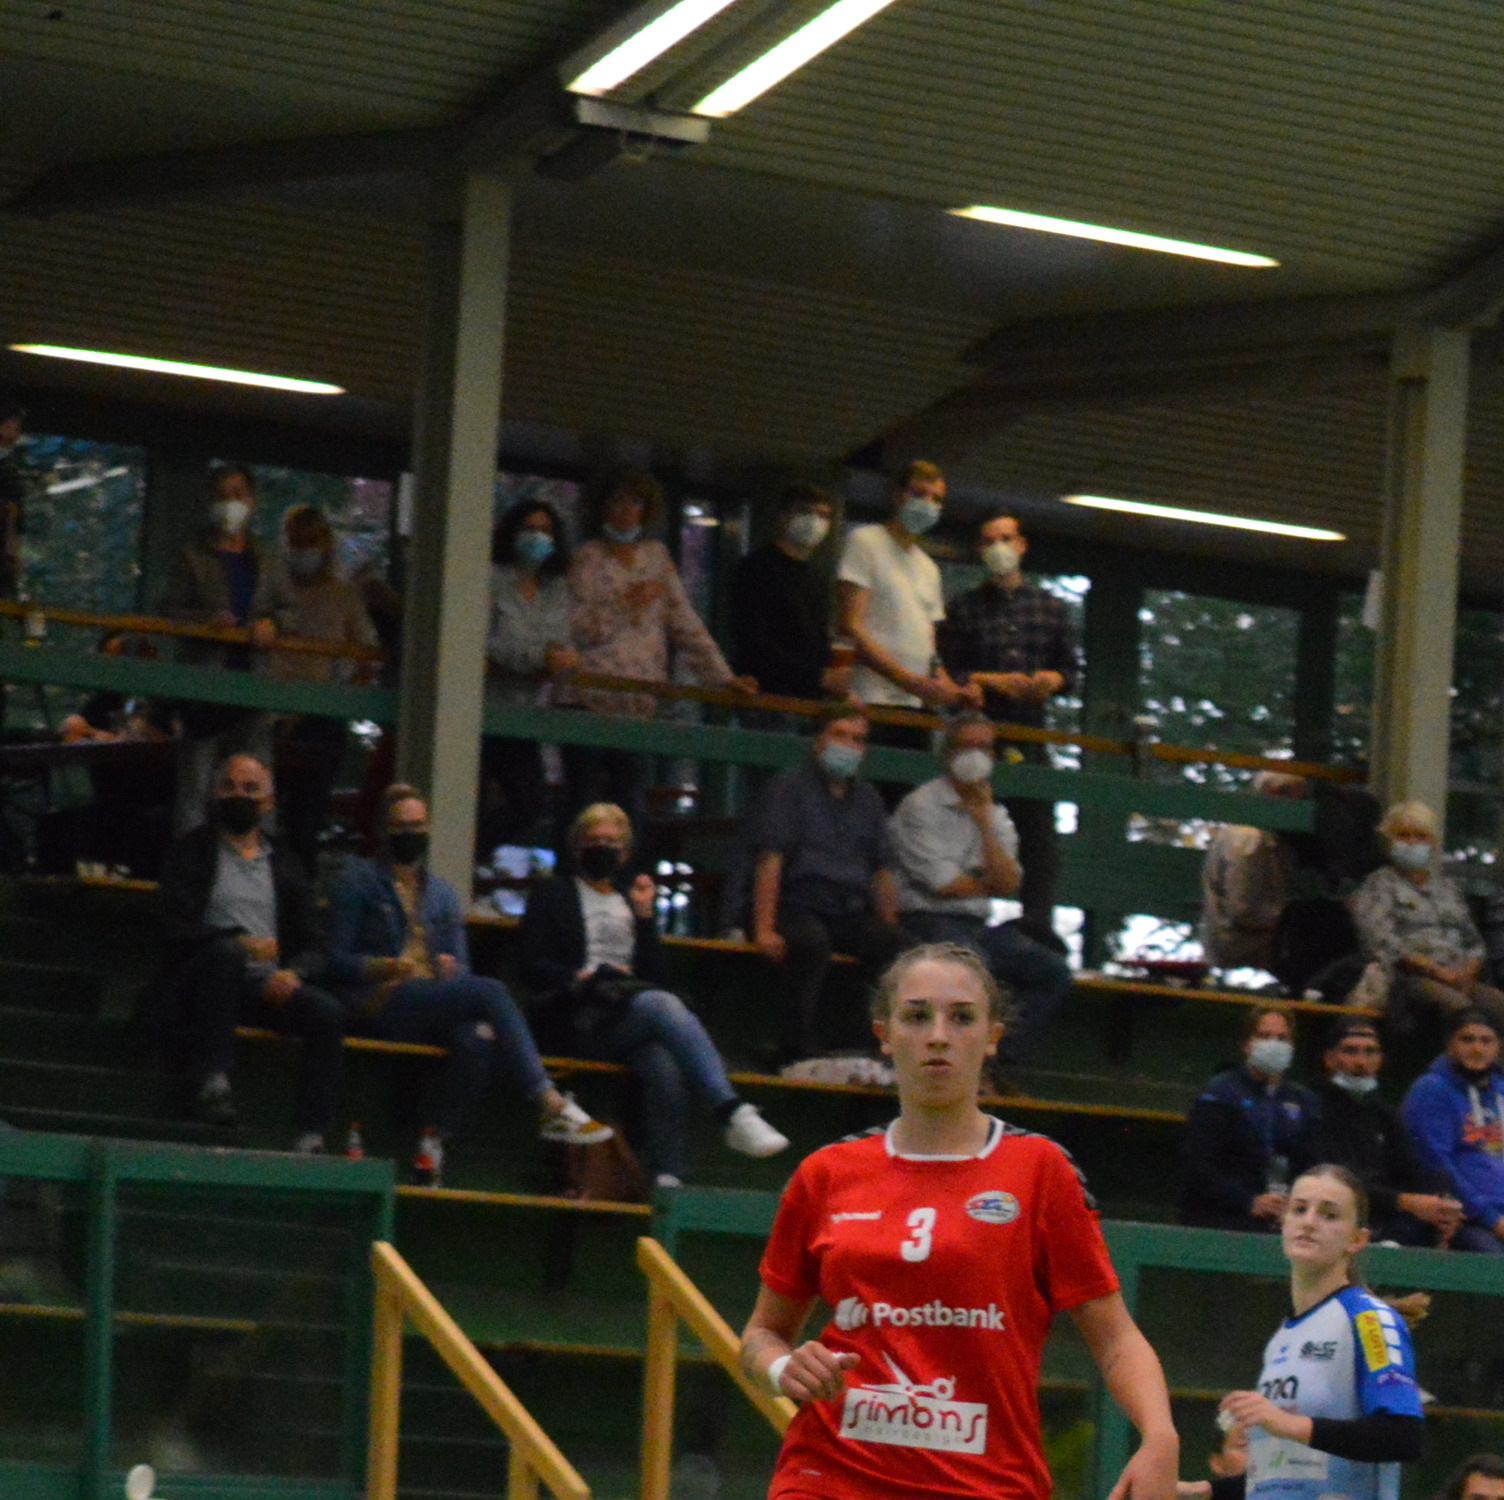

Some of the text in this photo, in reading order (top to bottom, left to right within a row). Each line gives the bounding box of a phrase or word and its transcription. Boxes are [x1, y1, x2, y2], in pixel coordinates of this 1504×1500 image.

[901, 1207, 936, 1262] 3
[873, 1300, 1005, 1331] Postbank
[848, 1394, 985, 1443] simons
